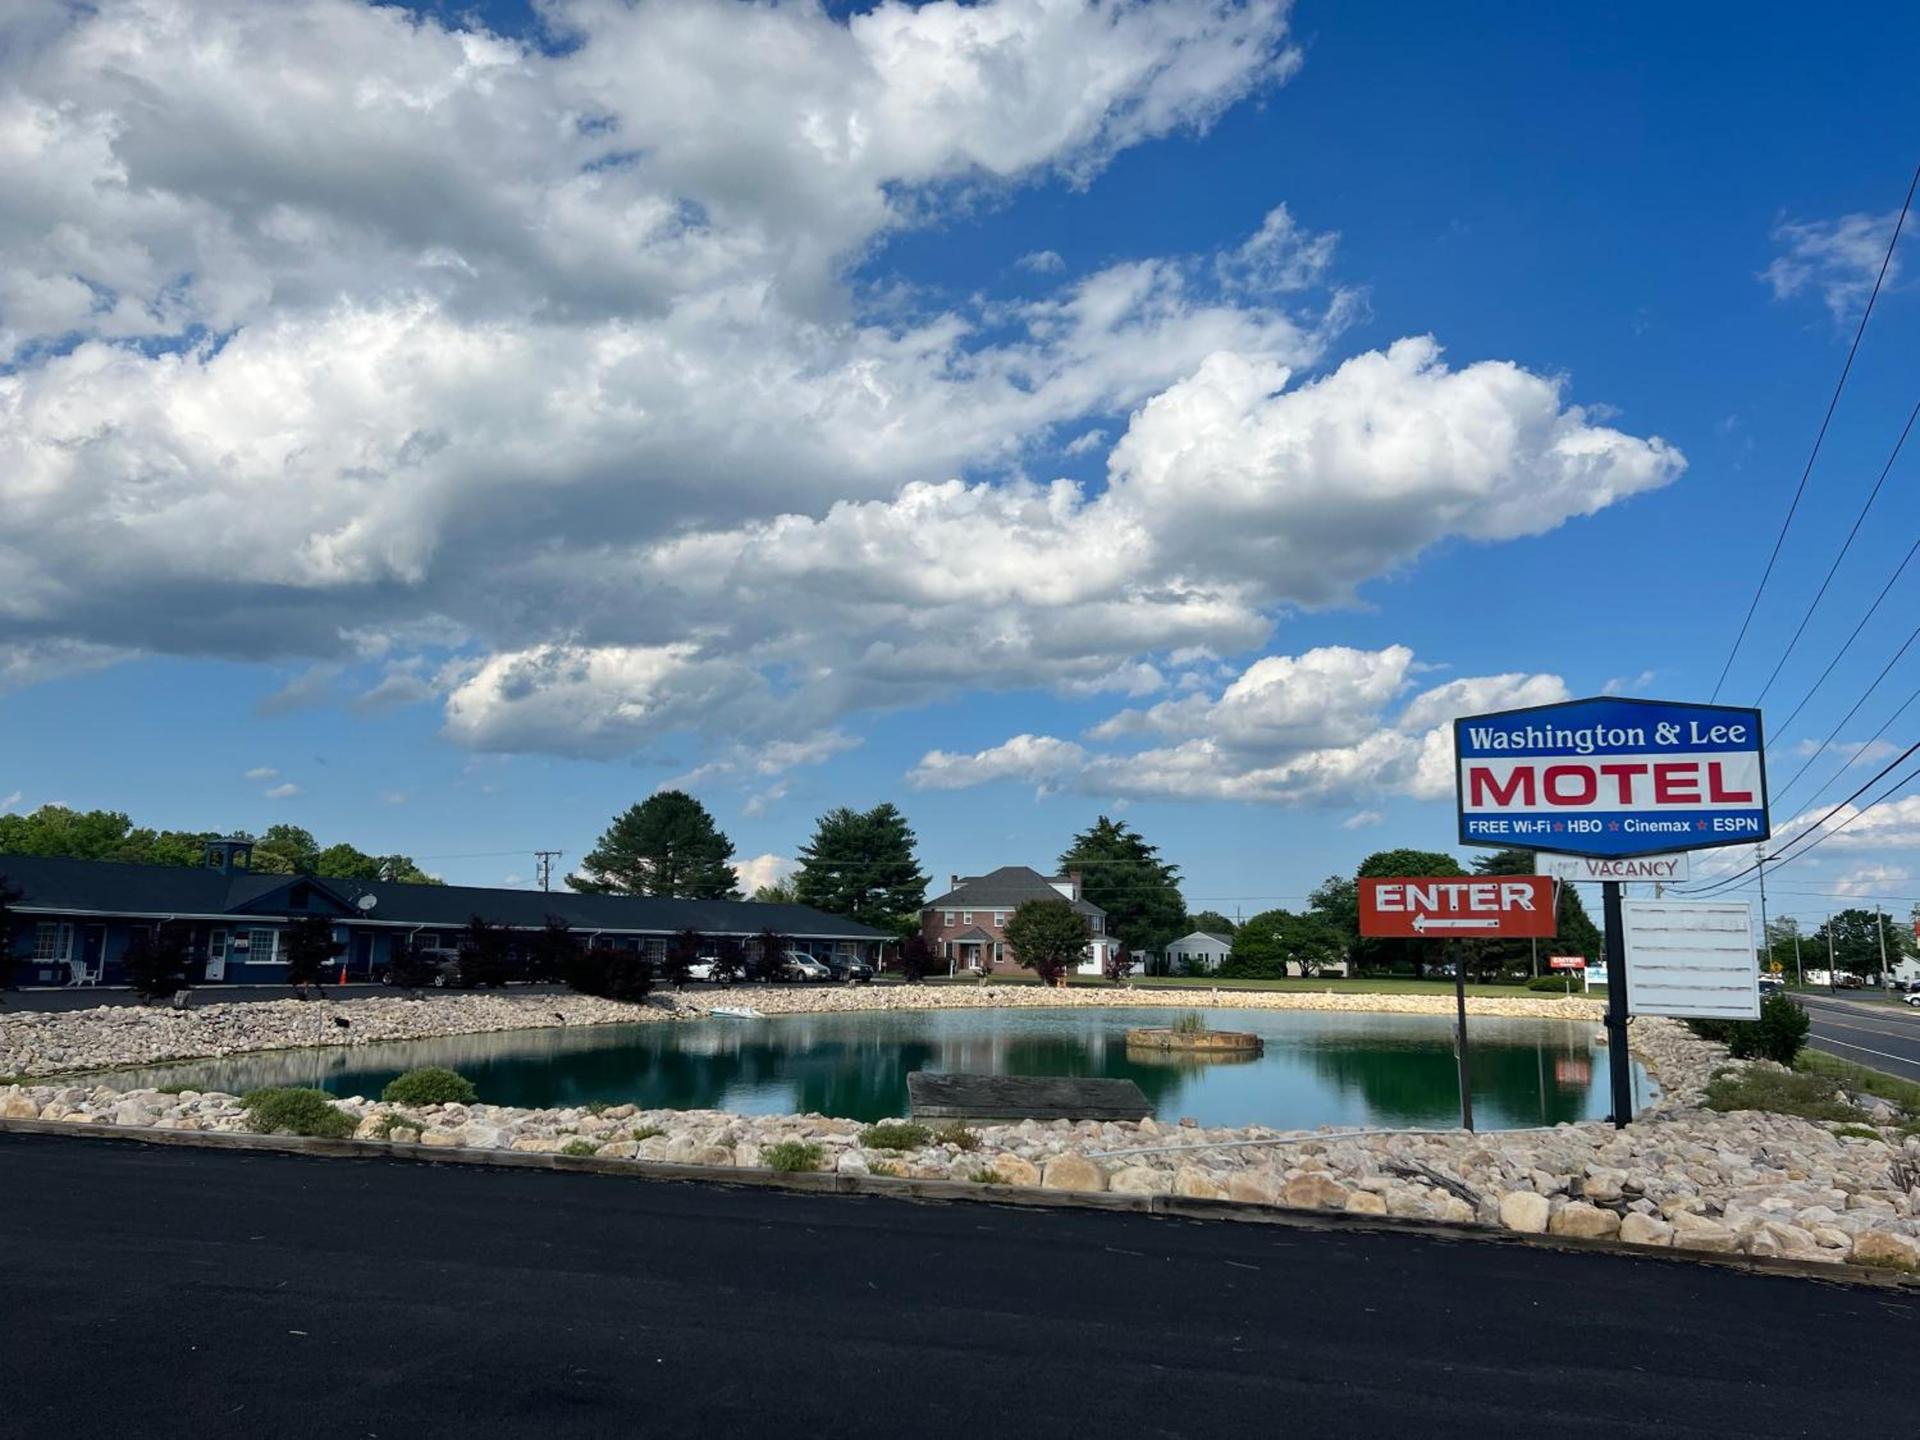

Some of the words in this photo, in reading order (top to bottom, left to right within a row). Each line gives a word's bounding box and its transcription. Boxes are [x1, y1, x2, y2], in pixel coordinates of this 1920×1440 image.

[1468, 724, 1645, 754] Washington
[1654, 721, 1681, 746] &
[1690, 720, 1747, 744] Lee
[1469, 761, 1753, 807] MOTEL
[1469, 820, 1509, 834] FREE
[1513, 819, 1551, 834] Wi-Fi
[1567, 819, 1602, 833] HBO
[1624, 818, 1691, 833] Cinemax
[1713, 817, 1759, 832] ESPN
[1586, 858, 1679, 877] VACANCY
[1375, 882, 1537, 912] ENTER
